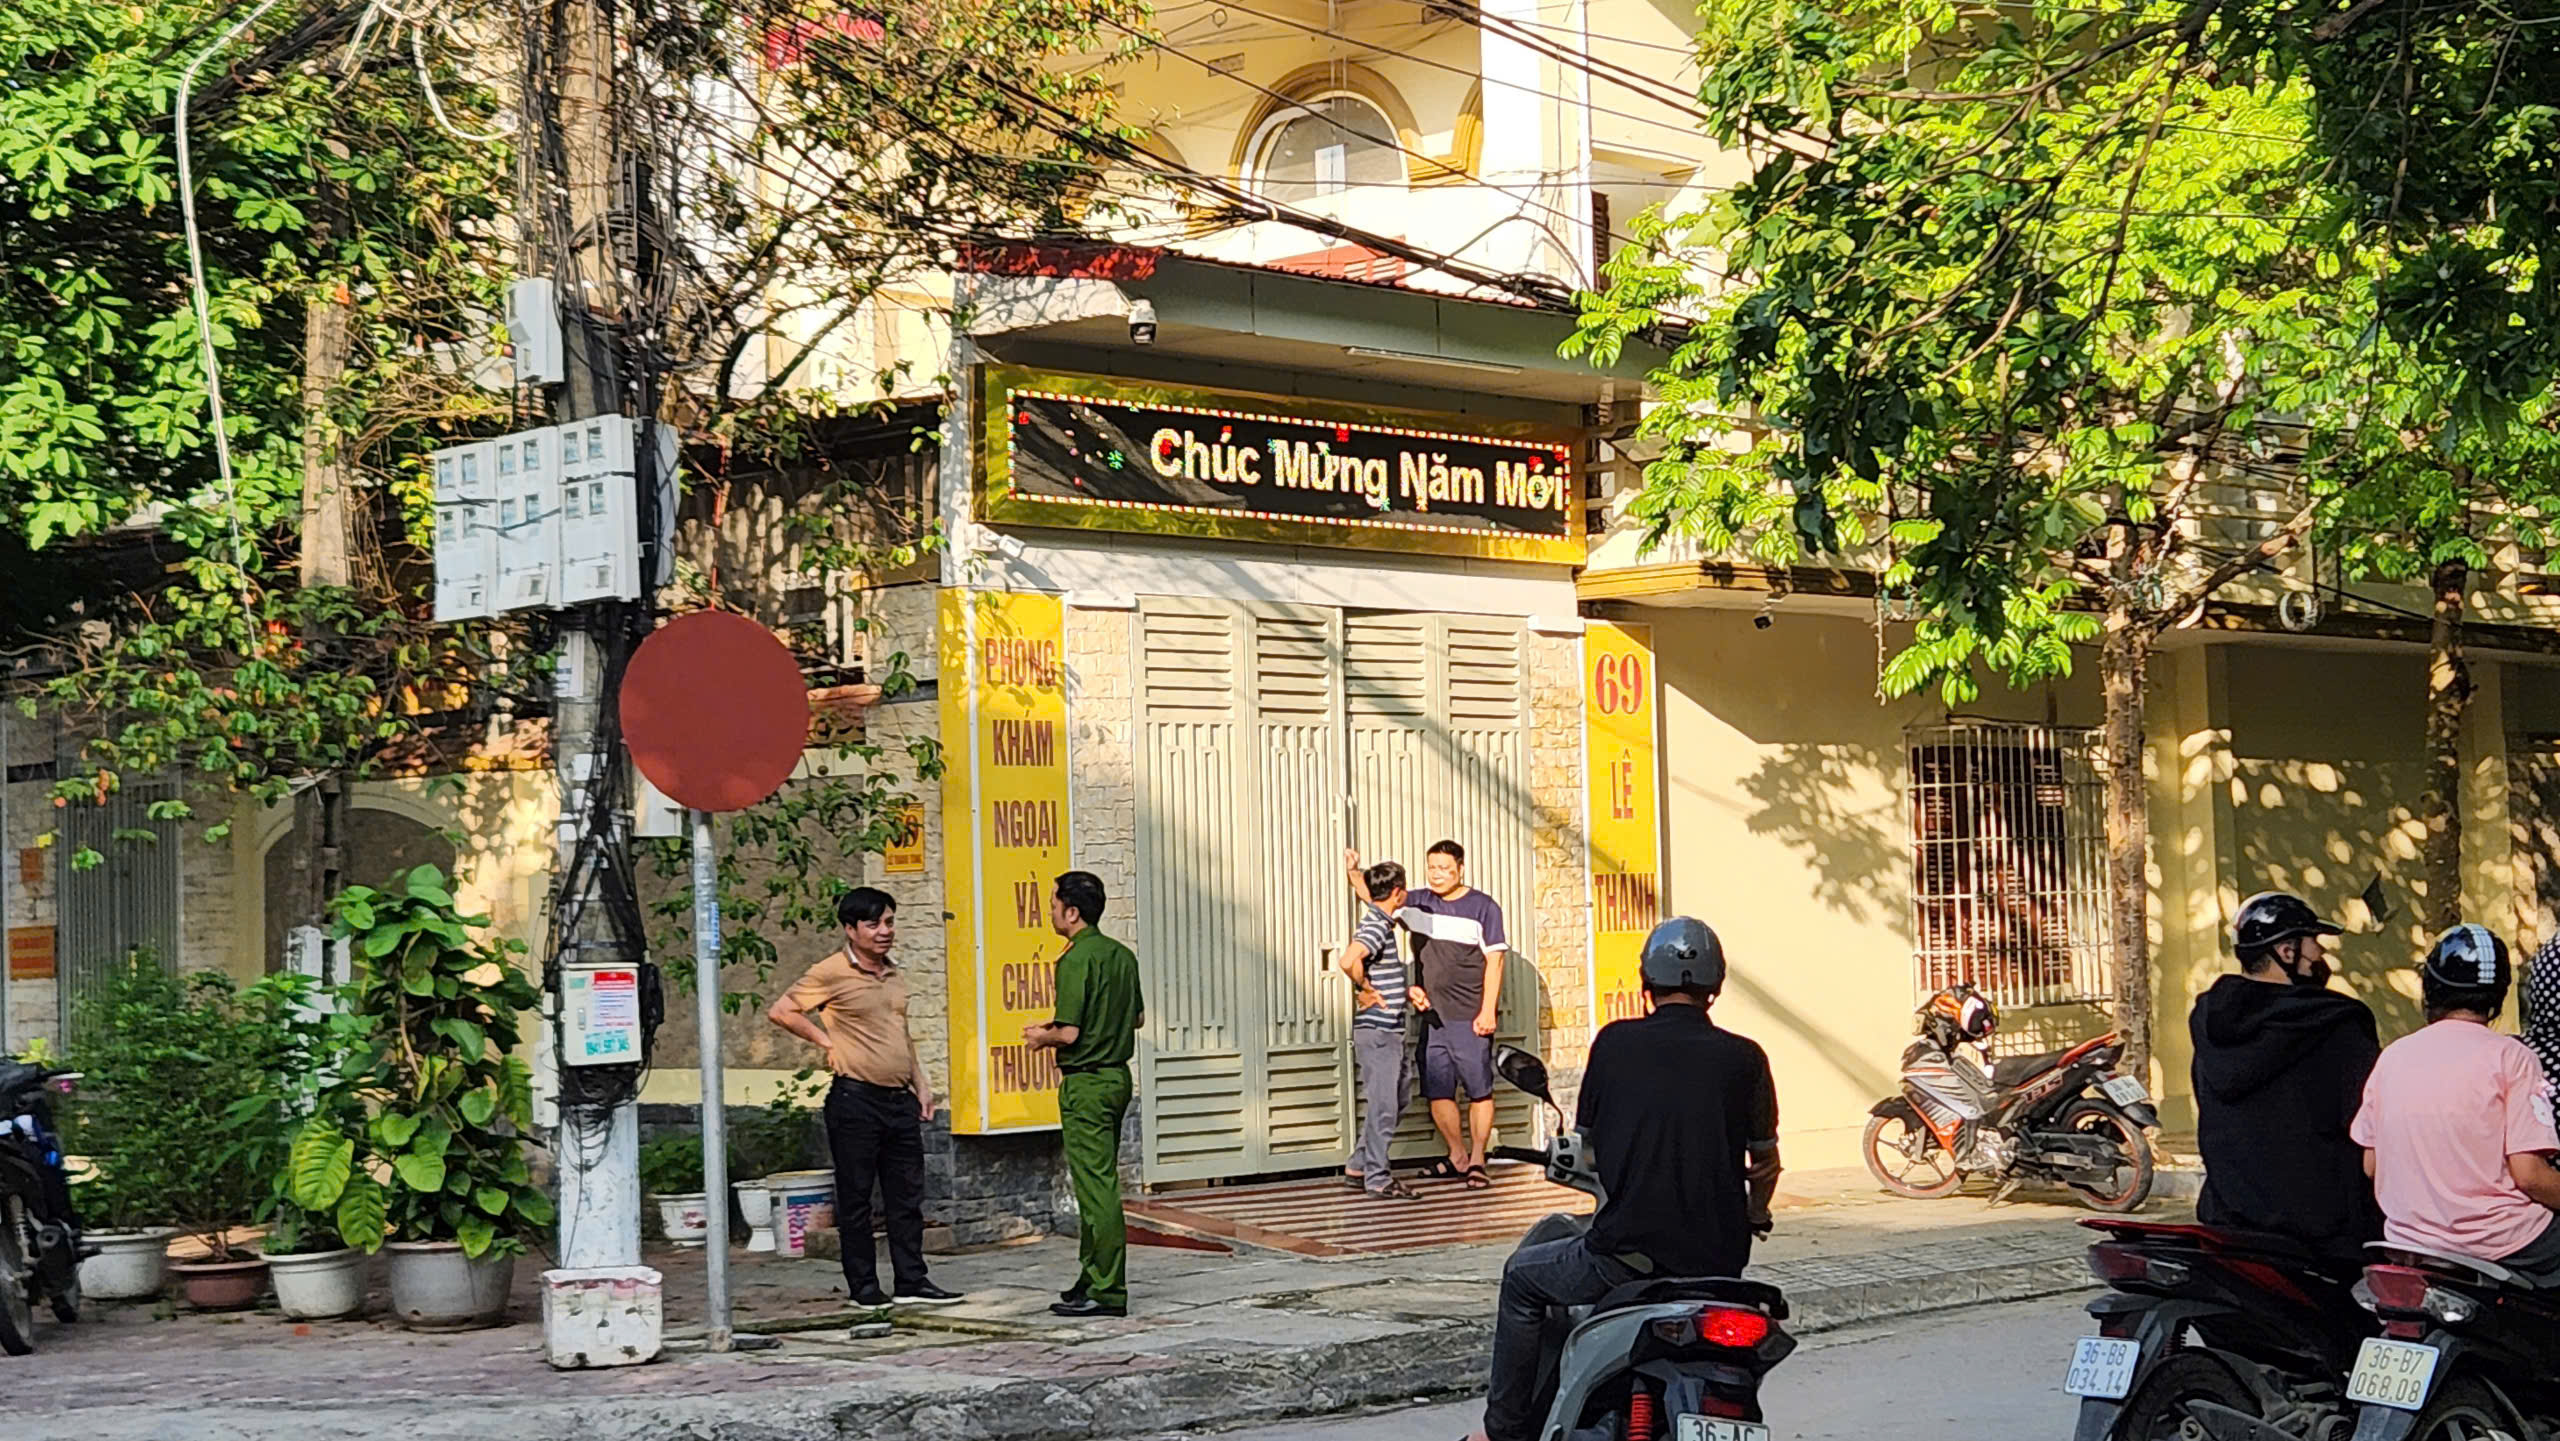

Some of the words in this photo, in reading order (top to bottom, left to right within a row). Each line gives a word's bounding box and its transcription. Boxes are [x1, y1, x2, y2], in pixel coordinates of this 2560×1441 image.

[1150, 425, 1261, 485] Chúc
[1271, 439, 1388, 507] Mừng
[1399, 450, 1485, 506] Năm
[1495, 458, 1564, 511] Mới
[984, 627, 1057, 687] PHÒNG
[1595, 653, 1643, 715] 69
[992, 709, 1054, 767] KHÁM
[1611, 748, 1634, 819] LÊ
[993, 800, 1058, 858] NGOẠI
[1014, 871, 1042, 929] VÀ
[1594, 860, 1657, 932] THÁNH
[2068, 1367, 2124, 1393] 034.14
[2080, 1341, 2127, 1366] 36-B8
[2368, 1345, 2424, 1375] 36-B7
[2354, 1371, 2422, 1403] 068.08
